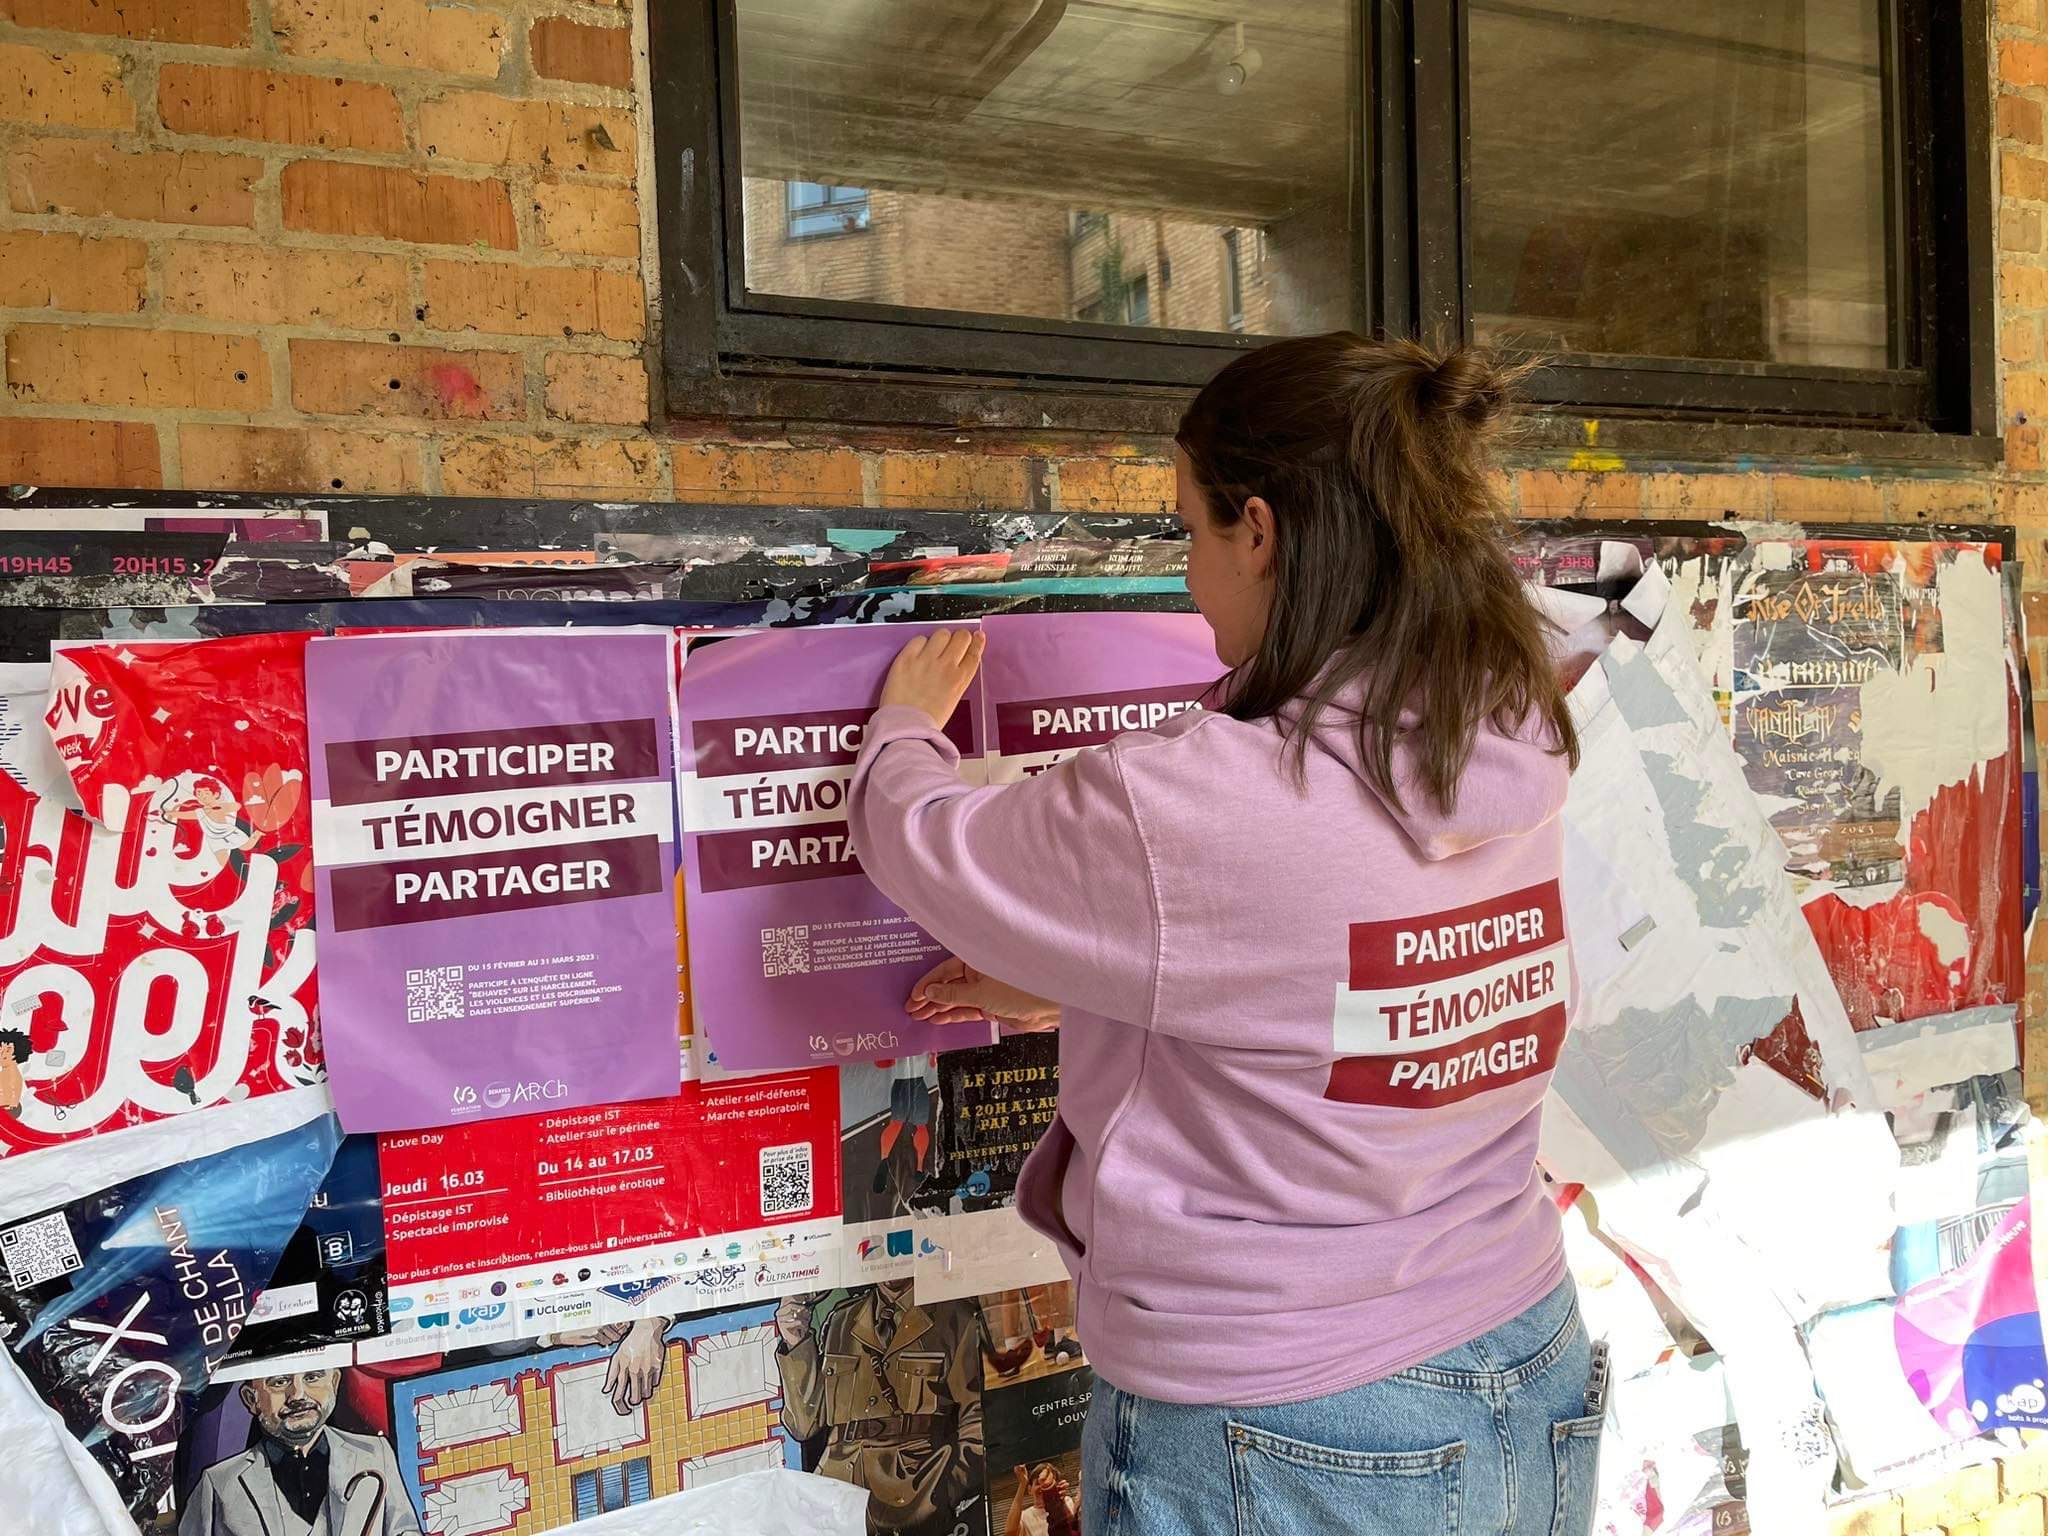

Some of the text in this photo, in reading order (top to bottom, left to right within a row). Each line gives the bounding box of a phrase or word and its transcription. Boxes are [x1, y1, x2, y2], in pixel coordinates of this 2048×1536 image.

[0, 556, 73, 573] 19H45
[112, 557, 186, 574] 20H15
[1559, 556, 1595, 568] 23H30
[375, 742, 615, 782] PARTICIPER
[361, 792, 636, 851] TÉMOIGNER
[395, 859, 611, 905] PARTAGER
[883, 917, 902, 925] MARS
[813, 938, 846, 947] PARTICIPE
[900, 931, 918, 939] LIGNE
[1395, 907, 1545, 966] PARTICIPER
[468, 964, 480, 972] DU
[494, 960, 526, 969] FÉVRIER
[528, 959, 539, 967] AU
[552, 955, 574, 965] MARS
[576, 954, 595, 962] 2023
[827, 952, 863, 962] VIOLENCES
[887, 945, 941, 956] DISCRIMINATIONS
[814, 964, 832, 972] DANS
[833, 958, 887, 970] L'ENSEIGNEMENT
[468, 979, 508, 990] PARTICIPE
[510, 978, 517, 986] À
[518, 974, 559, 985] L'ENQUÊTE
[572, 971, 594, 979] LIGNE
[513, 986, 528, 994] SUR
[530, 985, 539, 993] LE
[469, 999, 484, 1007] LES
[486, 995, 528, 1006] VIOLENCES
[557, 985, 622, 998] DISCRIMINATIONS
[1378, 960, 1555, 1041] TÉMOIGNER
[469, 1008, 492, 1016] DANS
[493, 1001, 557, 1014] L'ENSEIGNEMENT
[856, 1030, 899, 1052] ARCh
[1388, 1033, 1539, 1092] PARTAGER
[962, 1073, 986, 1088] LE
[991, 1066, 1047, 1085] JEUDI
[513, 1079, 568, 1104] ARCh
[706, 1086, 808, 1108] Atelier self-défense
[546, 1109, 621, 1130] Dépistage IST
[706, 1102, 811, 1122] Marche exploratoire
[975, 1102, 1007, 1117] 20H
[1011, 1100, 1023, 1112] A
[546, 1121, 661, 1144] Atelier sur le périnée
[979, 1116, 1010, 1131] PAF
[1018, 1114, 1027, 1126] 3
[390, 1133, 444, 1149] Love Day
[949, 1143, 1018, 1161] PREVENTES
[538, 1146, 655, 1177] Du 14 au 17.03
[383, 1170, 485, 1198] Jeudi 16.03
[546, 1176, 666, 1202] Bibliothèque érotique
[392, 1203, 474, 1226] Dépistage IST
[392, 1213, 510, 1240] Spectacle improvisé
[155, 1206, 209, 1301] CHANT
[386, 1240, 604, 1281] Pour plus d'infos et inscriptions, rendez-vous sur
[468, 1299, 593, 1318] kap UCLouvain
[563, 1309, 592, 1319] SPORTS
[193, 1304, 225, 1346] DE
[1031, 1392, 1093, 1416] CENTRE SP
[1057, 1410, 1088, 1427] LOUV
